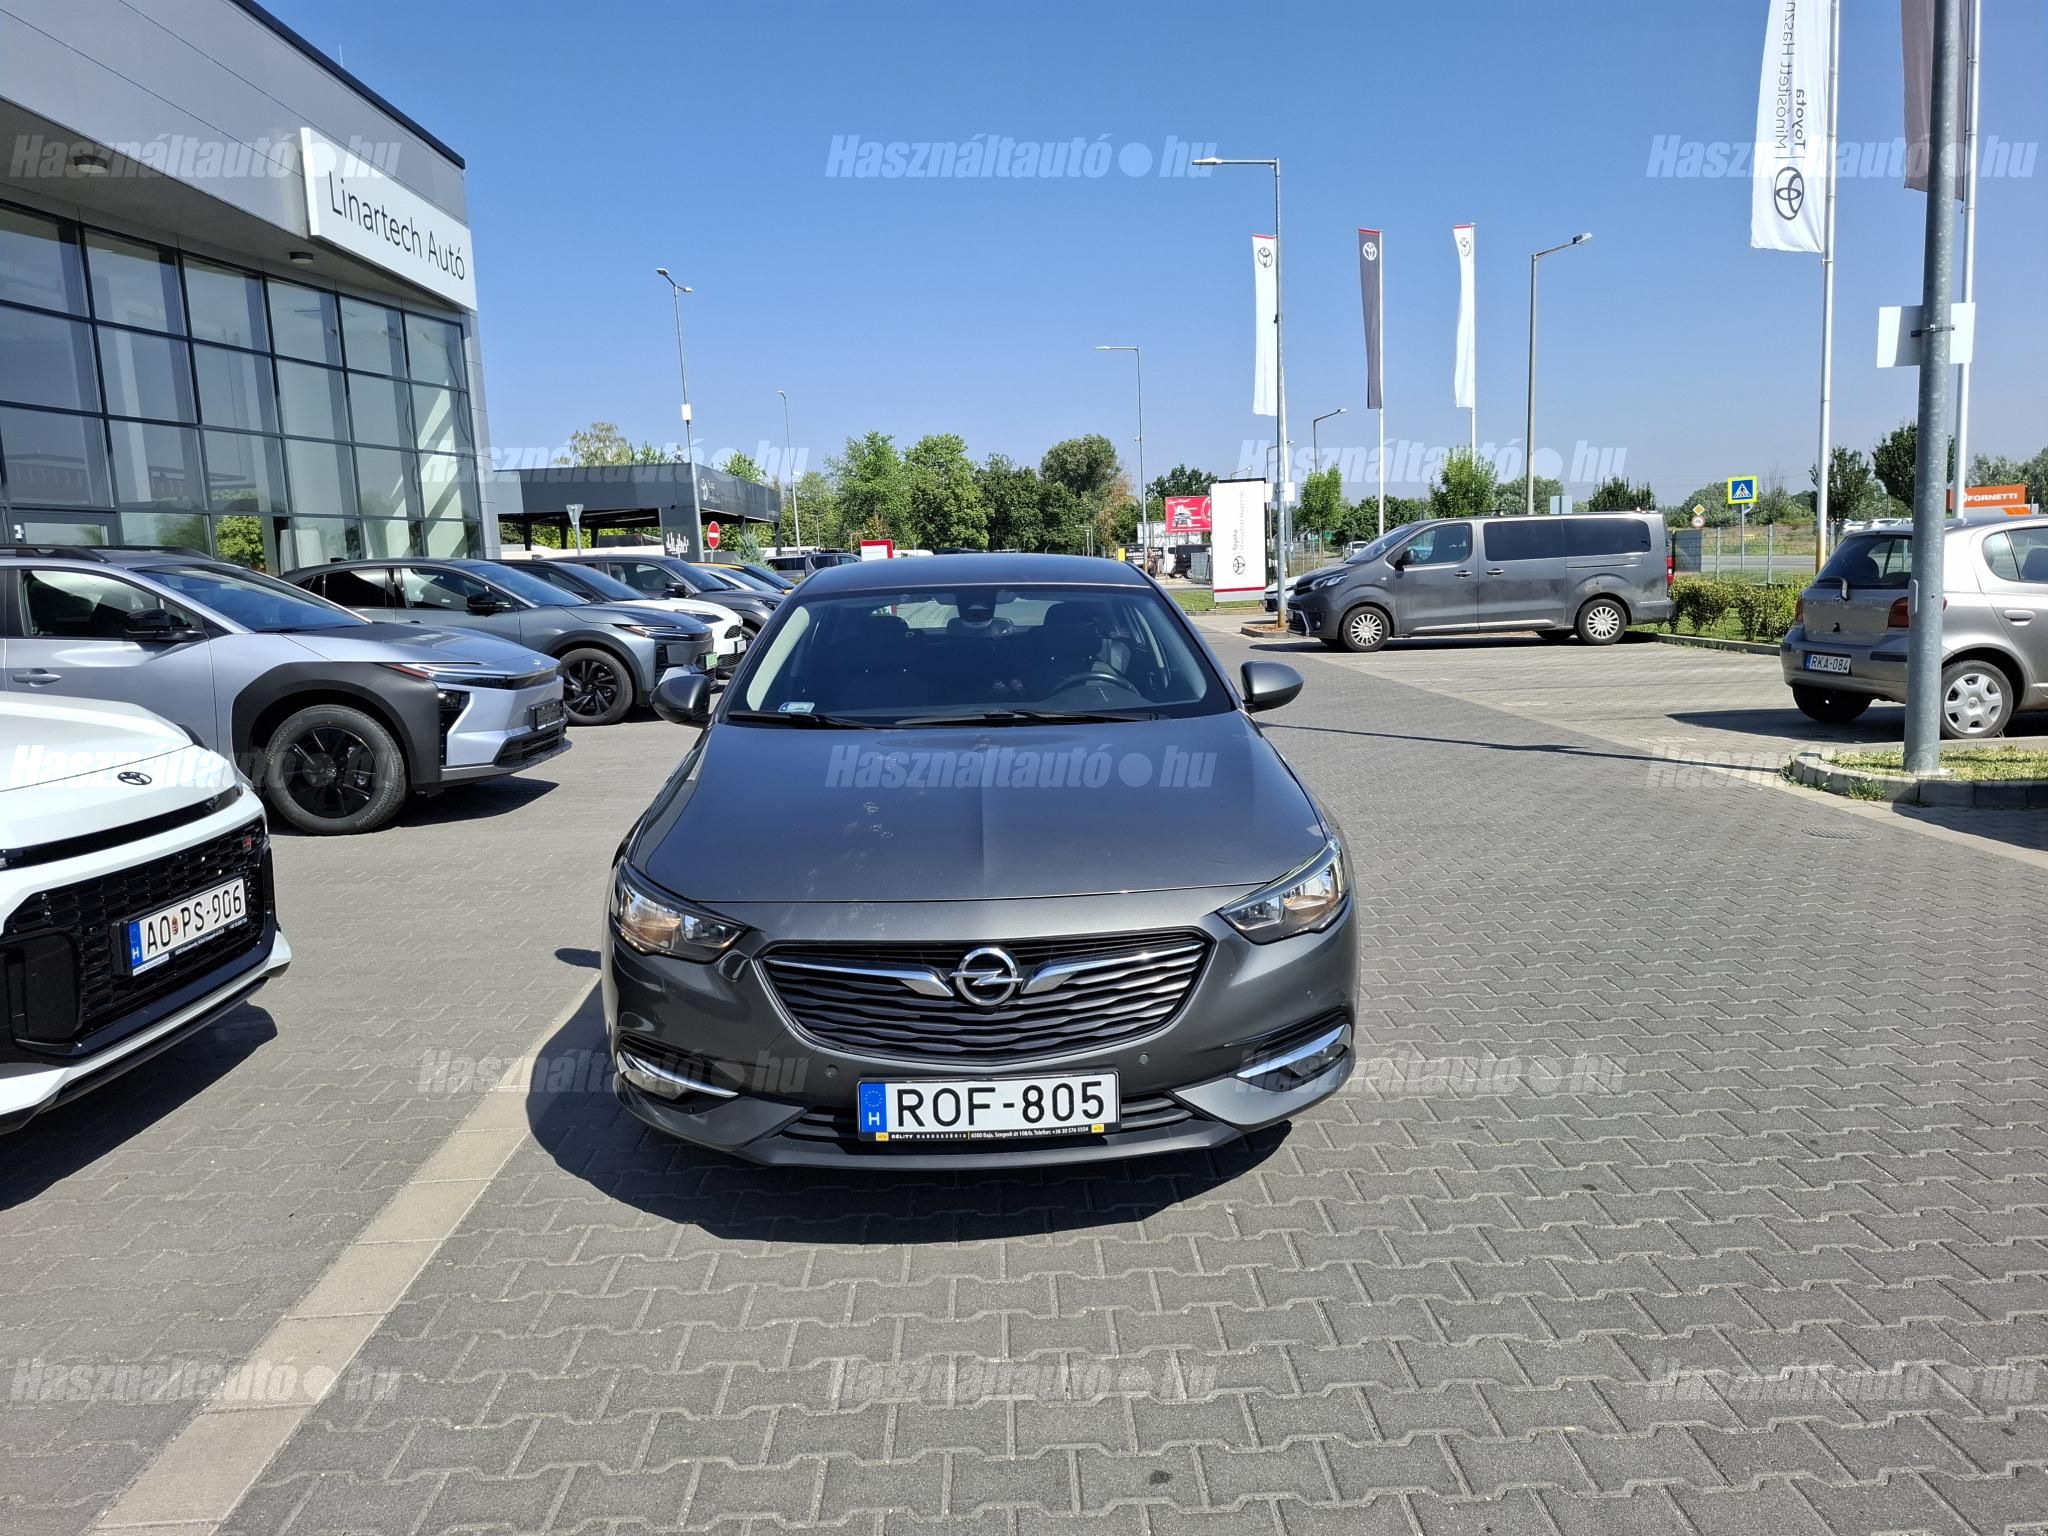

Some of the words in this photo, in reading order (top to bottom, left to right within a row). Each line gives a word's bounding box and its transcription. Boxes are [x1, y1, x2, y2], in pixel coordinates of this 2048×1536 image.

[328, 170, 423, 259] Linartech
[428, 230, 466, 281] Autó
[1967, 492, 2018, 502] FORNETTI
[1810, 656, 1849, 671] RKA-084
[131, 946, 141, 960] H
[896, 1080, 1105, 1127] ROF-805
[867, 1111, 881, 1126] H
